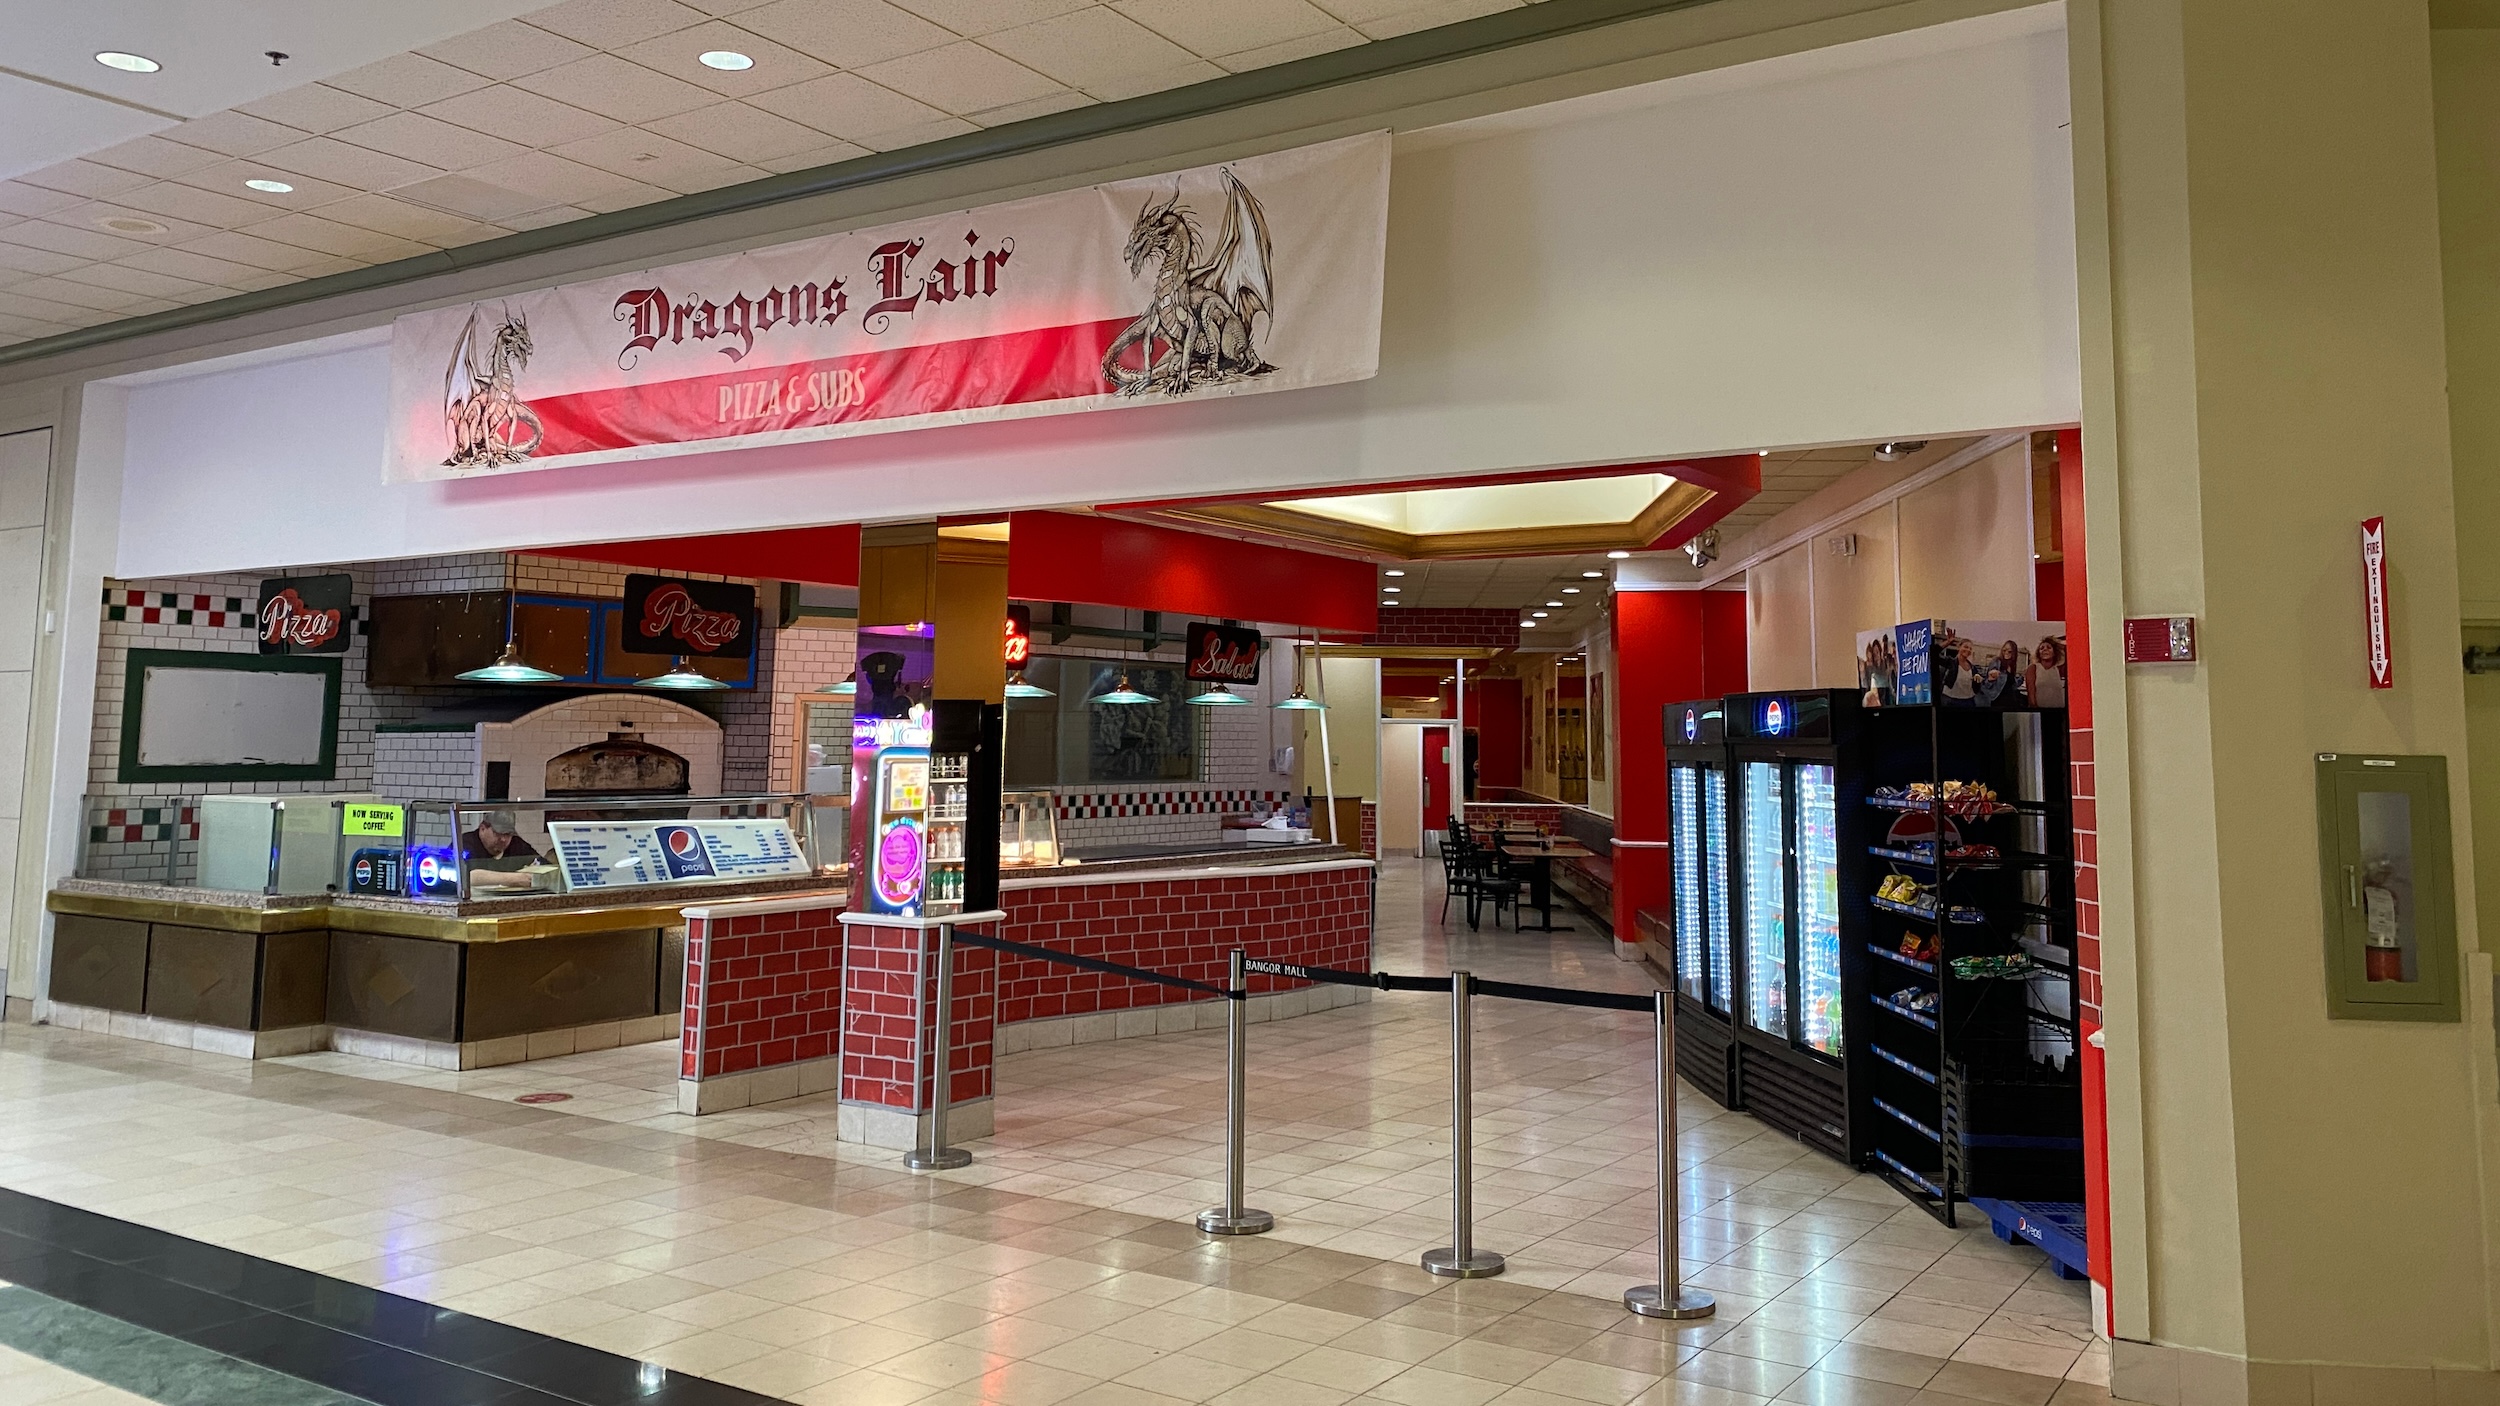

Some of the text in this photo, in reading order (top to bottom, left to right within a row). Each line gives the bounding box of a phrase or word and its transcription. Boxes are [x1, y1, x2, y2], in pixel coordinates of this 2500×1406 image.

[614, 229, 1015, 371] Dragons Lair
[718, 367, 867, 423] PIZZA & SUBS
[2366, 541, 2380, 556] FIRE
[260, 595, 329, 645] Pizza
[649, 590, 741, 647] Pizza
[2371, 558, 2383, 671] EXTINGUISHER
[1902, 627, 1927, 653] SHARE
[2128, 626, 2136, 655] FIRE
[1196, 638, 1260, 679] Salad
[1902, 652, 1928, 675] THE FUN
[352, 809, 394, 821] NOW SERVING
[681, 863, 706, 874] pepsi
[1245, 959, 1308, 978] BANGOR MALL
